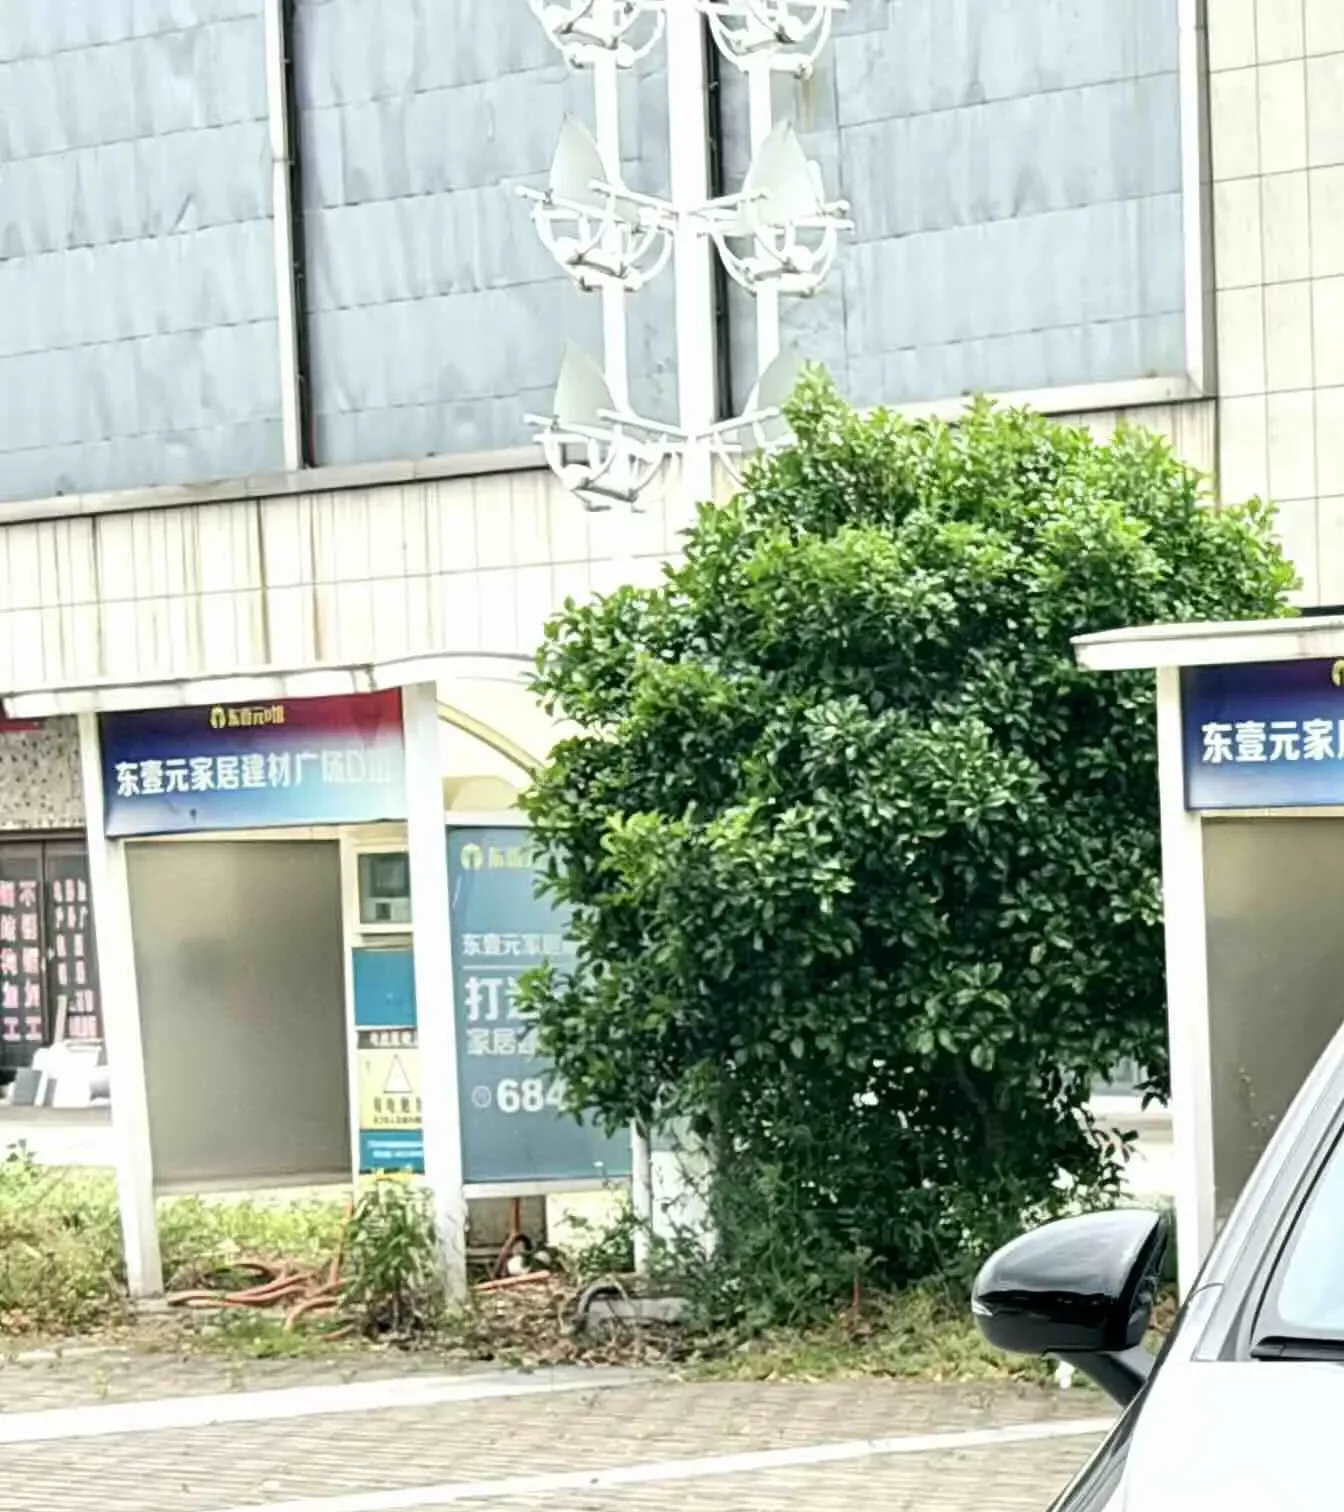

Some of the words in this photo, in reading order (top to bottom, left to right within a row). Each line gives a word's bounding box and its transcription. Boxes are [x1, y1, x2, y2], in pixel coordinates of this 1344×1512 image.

[115, 749, 391, 797] 东壹元家居建材广场D
